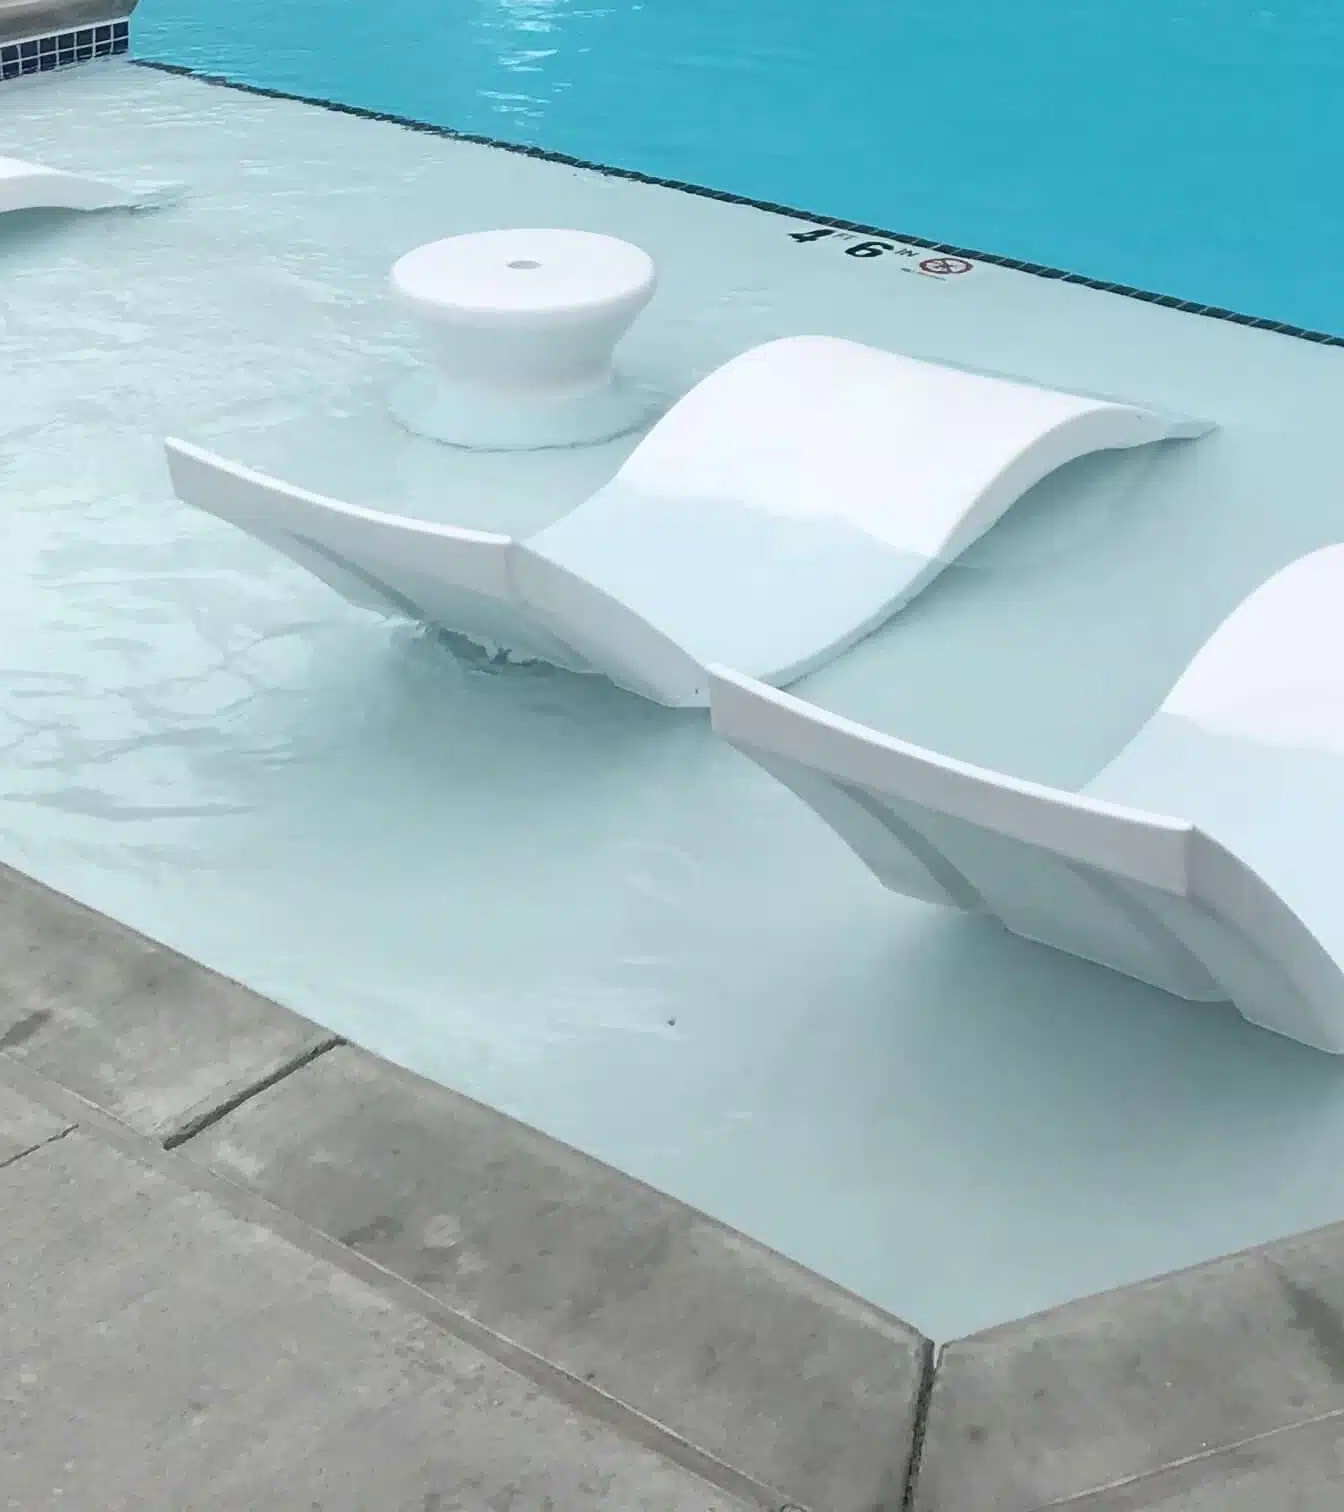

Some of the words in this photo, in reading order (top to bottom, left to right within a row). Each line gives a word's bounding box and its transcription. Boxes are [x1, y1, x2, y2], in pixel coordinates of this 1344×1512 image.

[787, 228, 835, 243] 4
[844, 241, 894, 258] 6
[894, 248, 920, 258] IN
